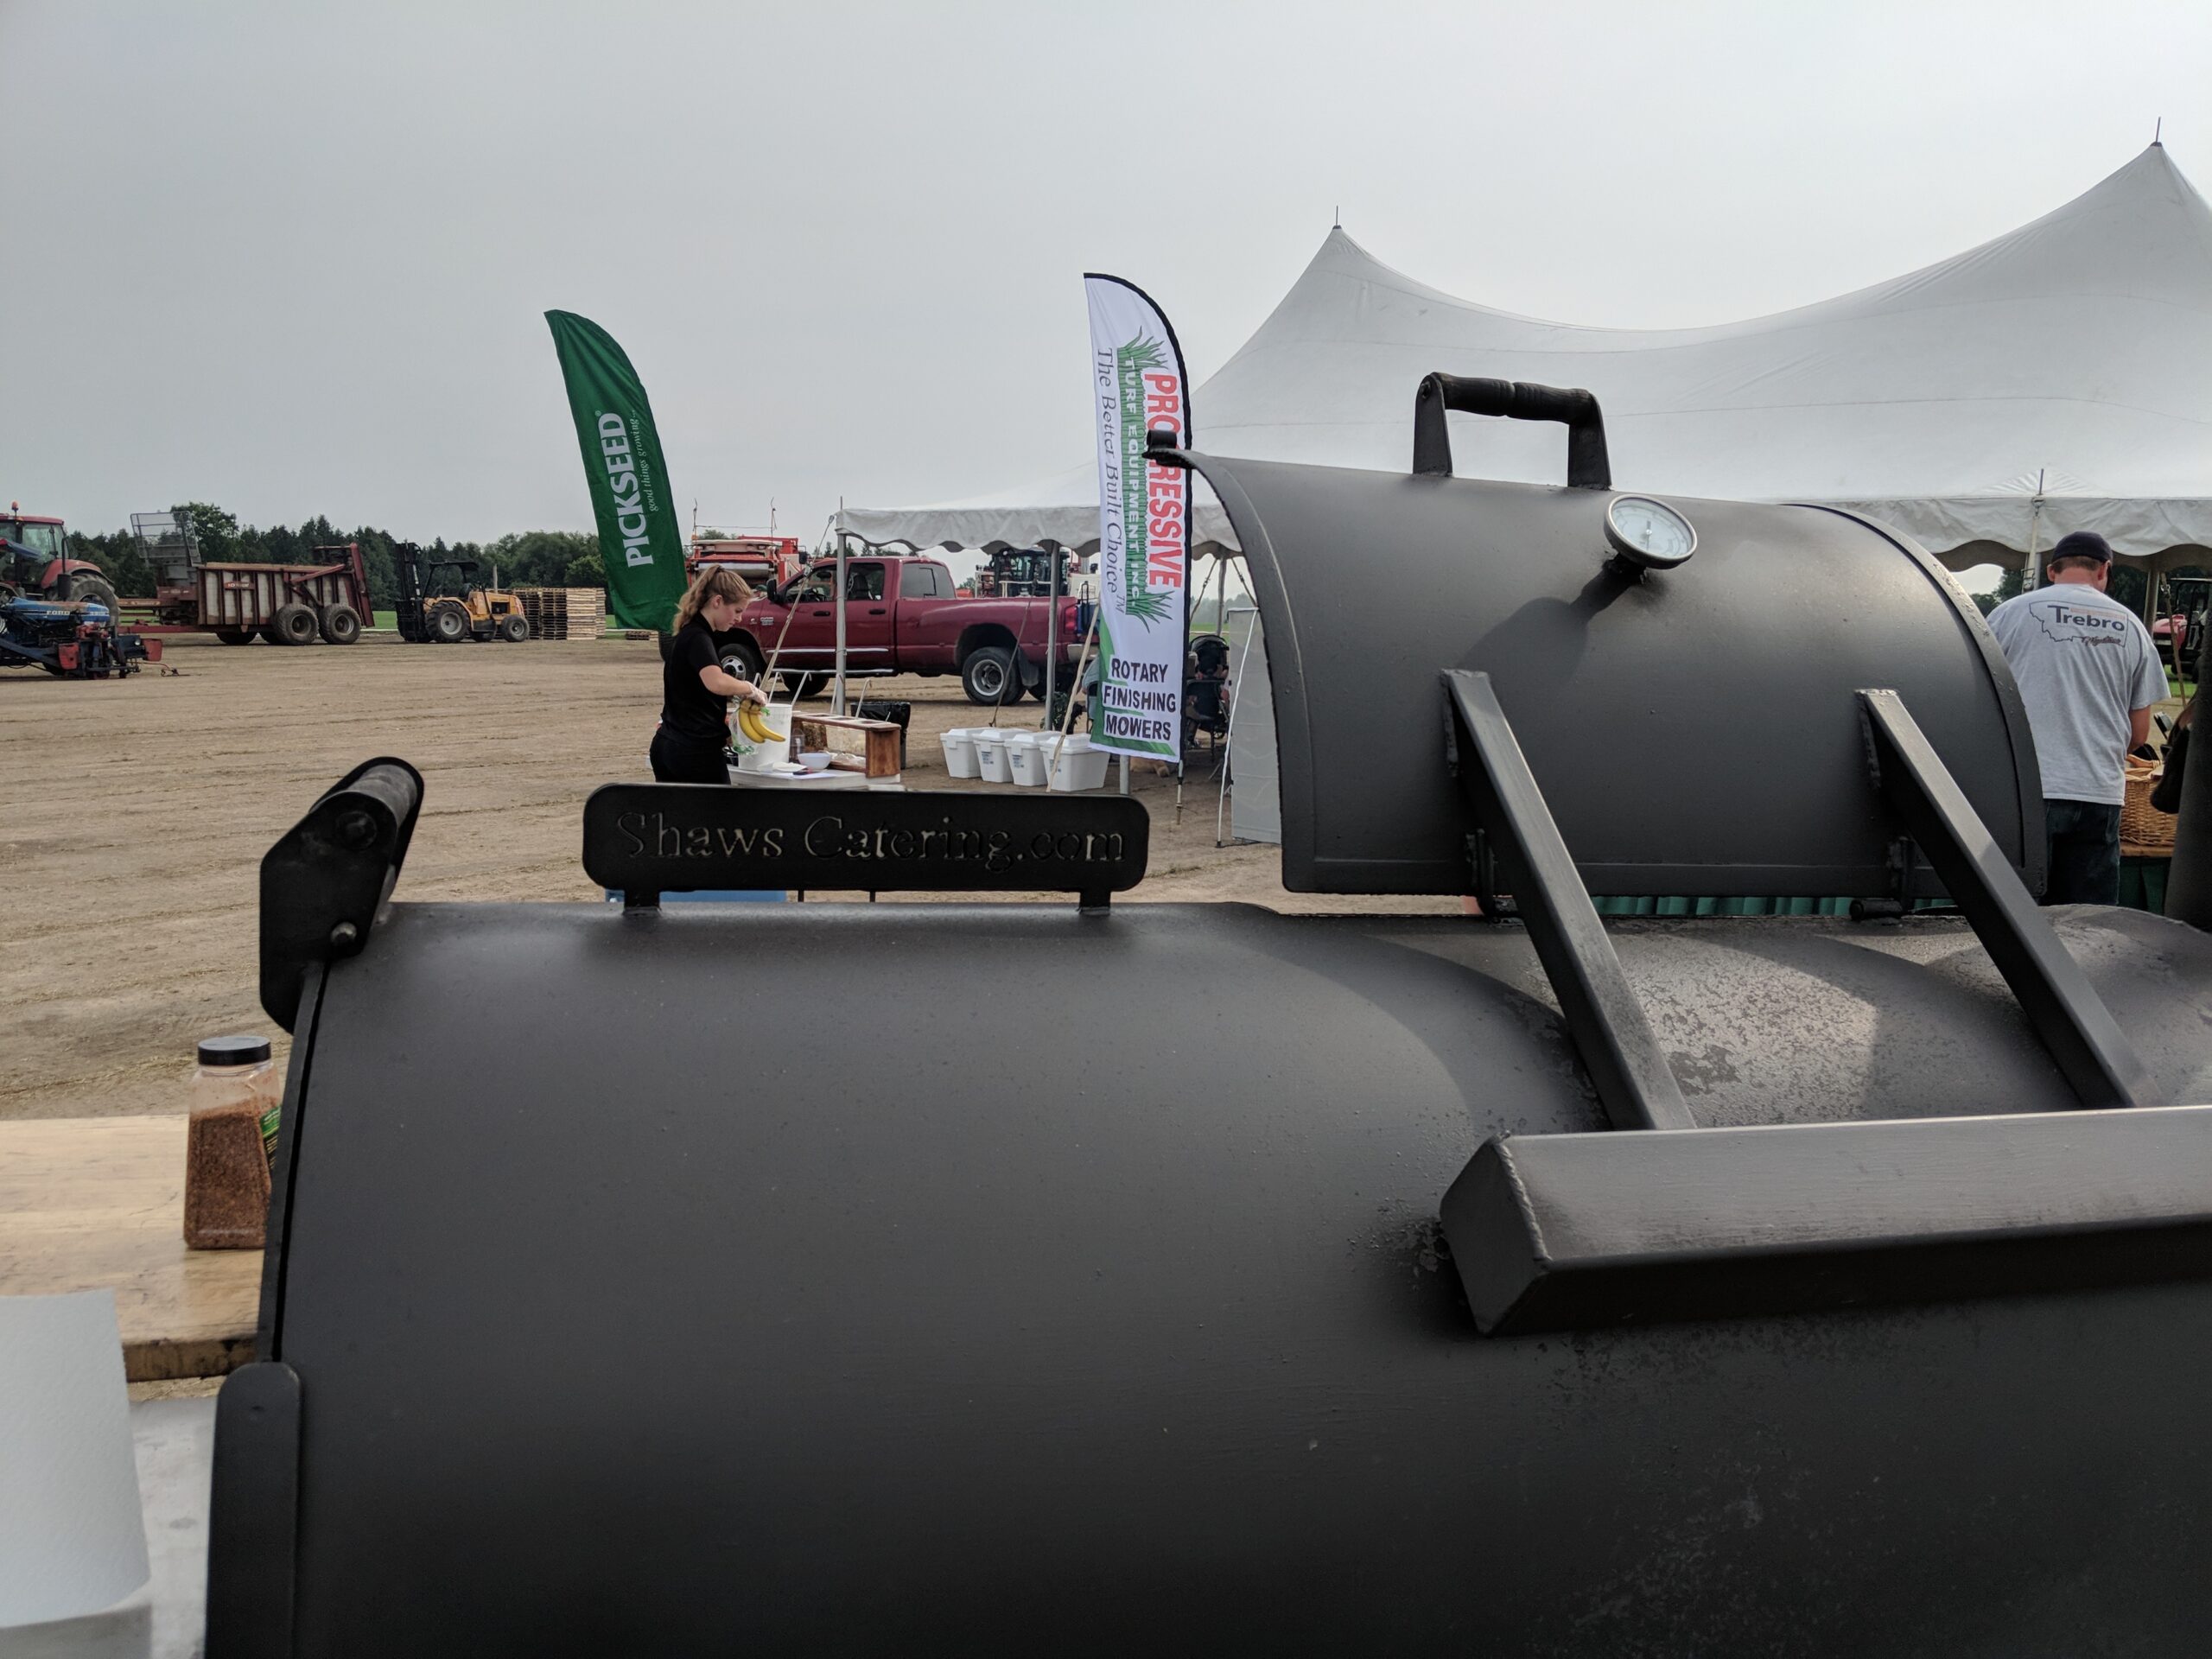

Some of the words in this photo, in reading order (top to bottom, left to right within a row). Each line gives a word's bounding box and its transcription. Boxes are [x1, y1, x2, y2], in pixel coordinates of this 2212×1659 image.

[1097, 346, 1114, 387] The
[1125, 357, 1137, 414] TURF
[1102, 396, 1116, 458] Better
[598, 413, 654, 567] PICKSEED
[639, 460, 650, 487] things
[643, 488, 658, 512] good
[1105, 463, 1122, 517] Built
[1128, 424, 1139, 553] EQUIPMENT
[1144, 373, 1182, 588] PRORESSIVE
[1106, 522, 1123, 594] Choice
[2047, 605, 2125, 632] Trebro
[1111, 658, 1168, 683] ROTARY
[1103, 685, 1176, 713] FINISHING
[1106, 714, 1171, 741] MOWERS
[617, 811, 784, 858] Shaws
[804, 815, 1123, 874] Catering.com
